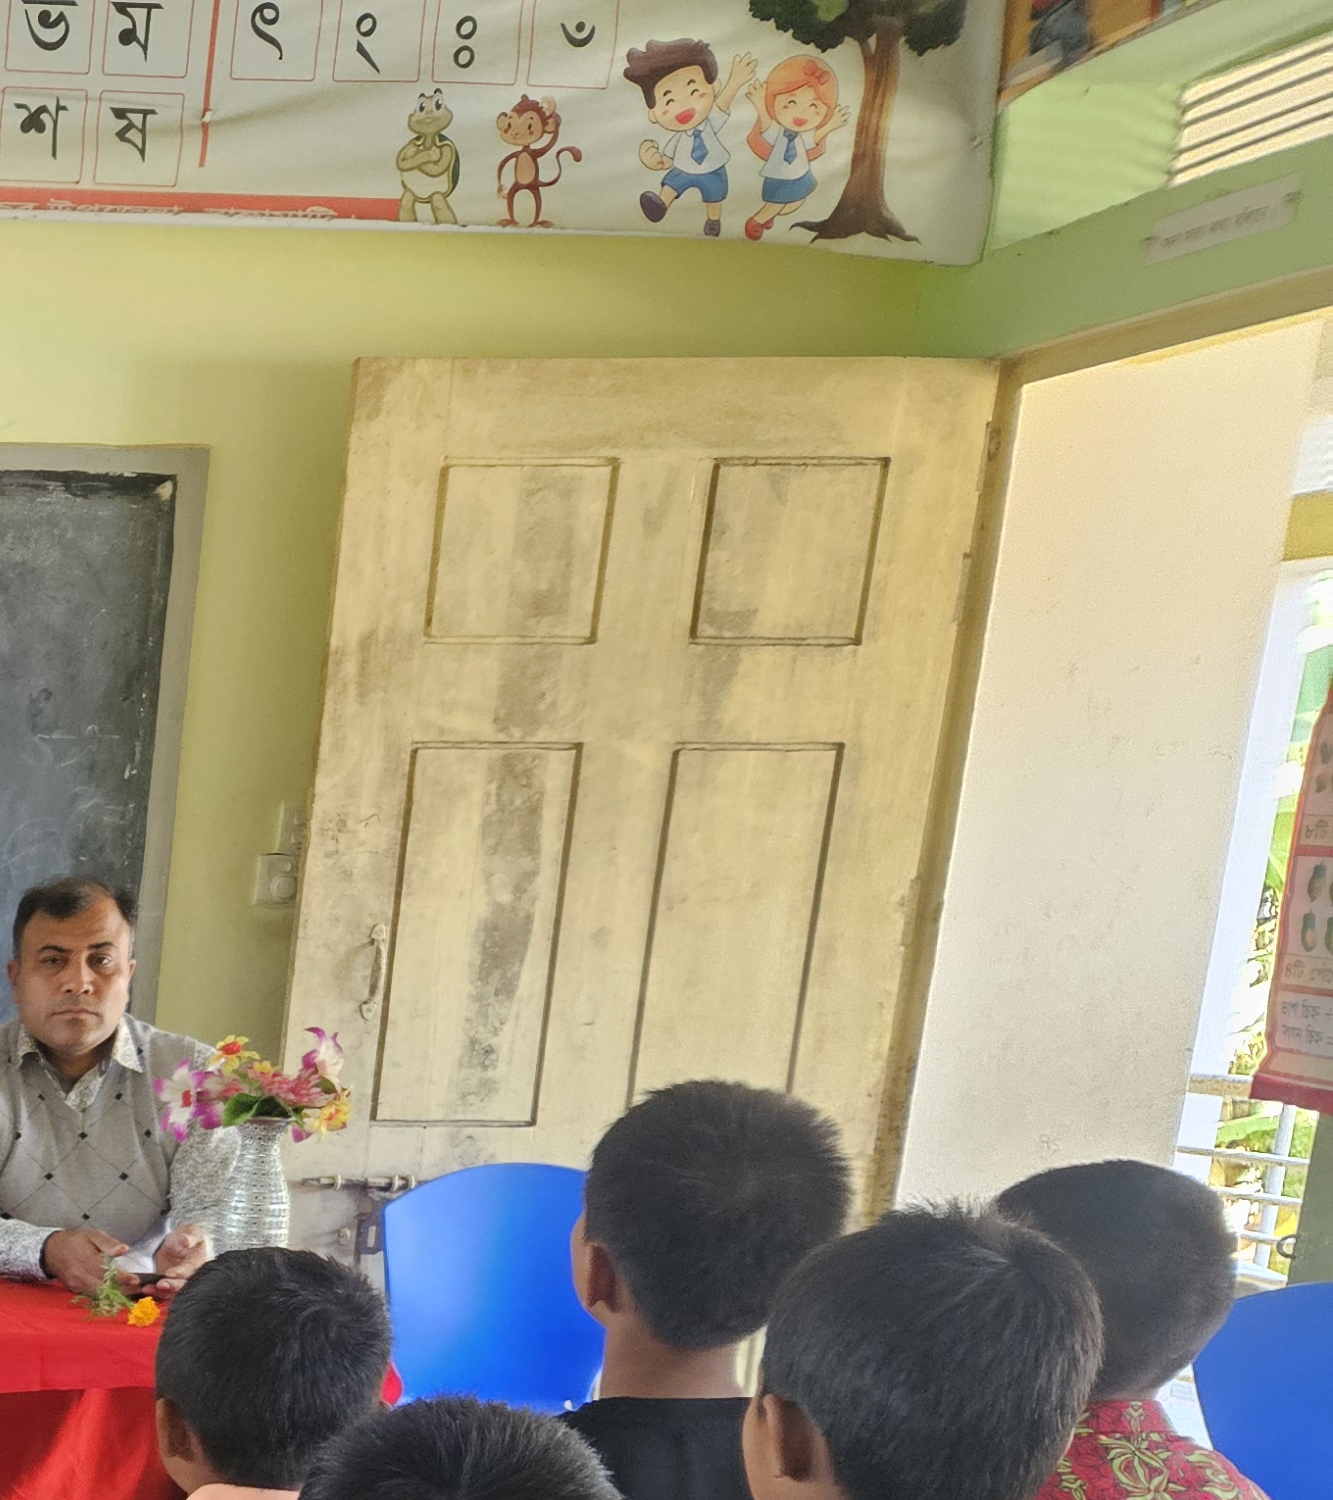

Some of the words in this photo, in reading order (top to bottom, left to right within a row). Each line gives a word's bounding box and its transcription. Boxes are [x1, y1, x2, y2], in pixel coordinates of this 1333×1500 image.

[23, 0, 78, 51] ভ
[111, 2, 164, 62] ম
[251, 2, 283, 60] ৎ
[356, 13, 380, 73] ং
[14, 97, 68, 159] শ
[110, 107, 157, 162] ষ
